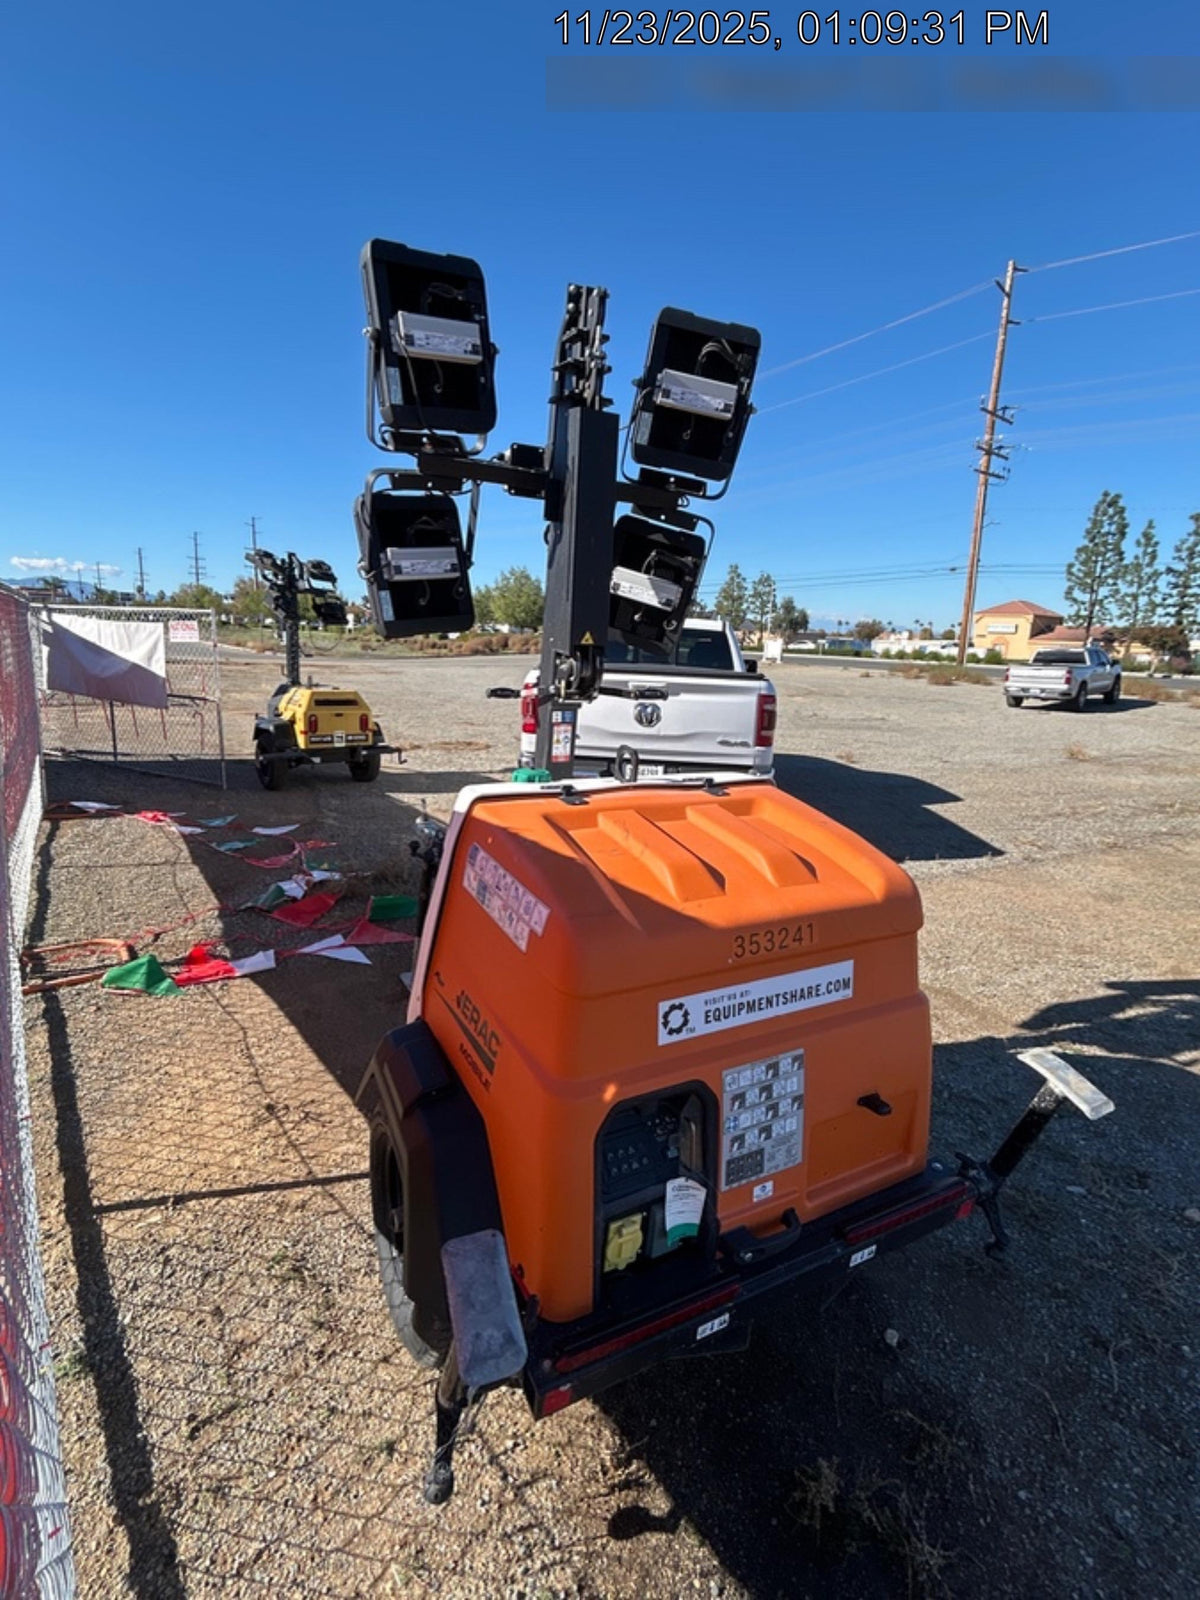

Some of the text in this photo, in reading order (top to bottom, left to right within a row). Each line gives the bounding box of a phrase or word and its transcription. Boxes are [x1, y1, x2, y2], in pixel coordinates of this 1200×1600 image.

[733, 923, 815, 959] 353241
[703, 976, 851, 1025] EQUIPMENTSHARE.COM
[704, 995, 724, 1006] VISIT
